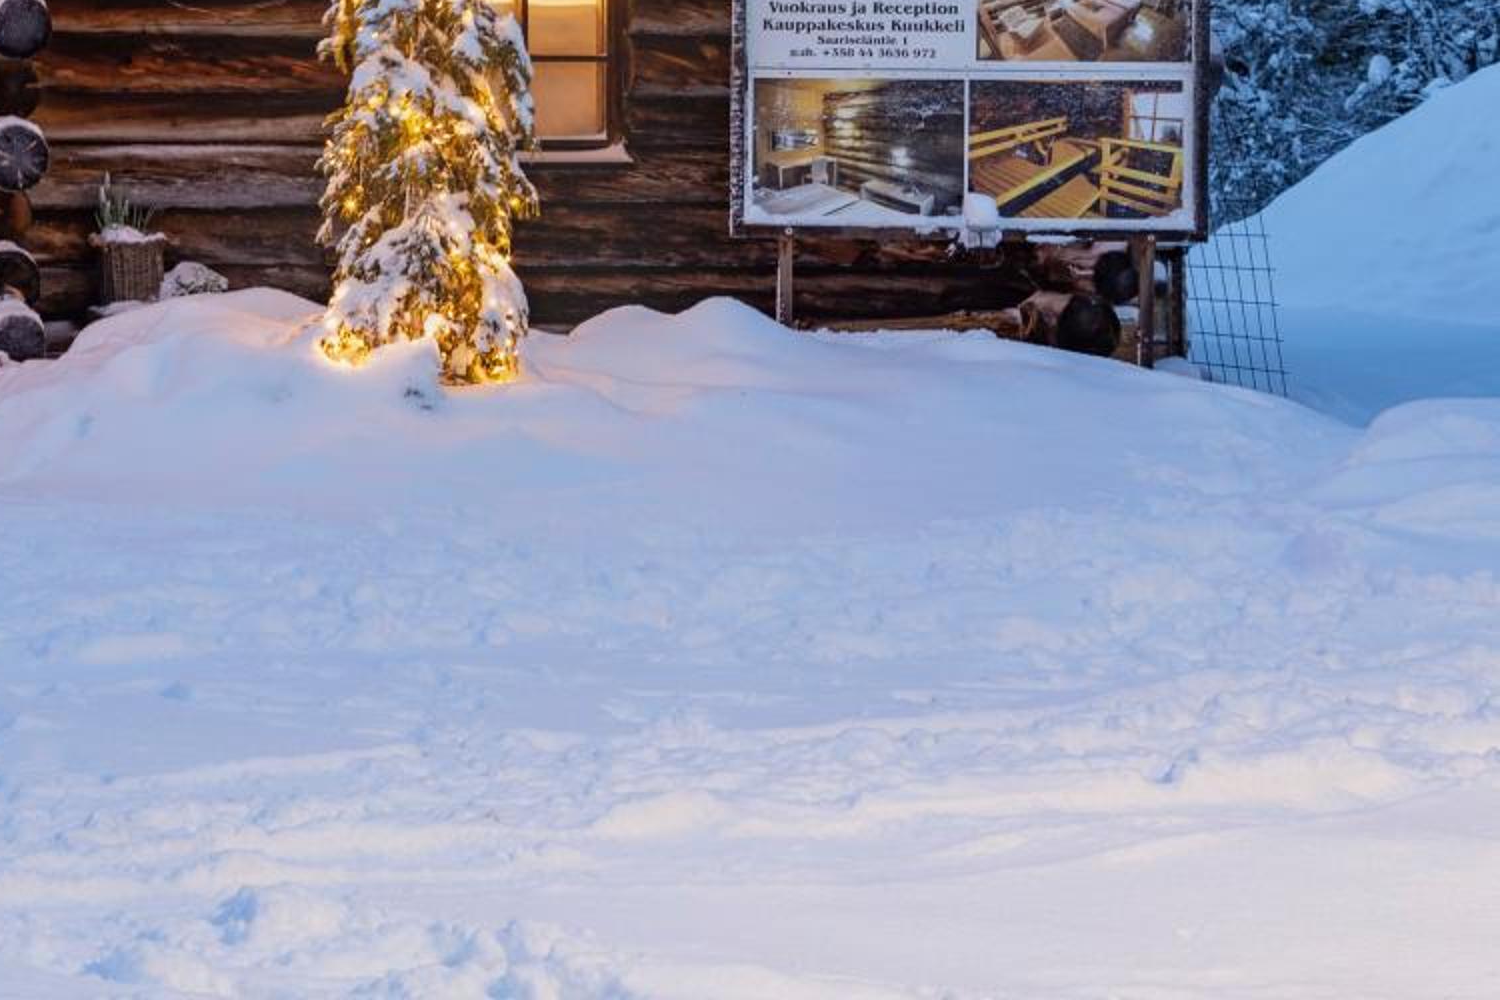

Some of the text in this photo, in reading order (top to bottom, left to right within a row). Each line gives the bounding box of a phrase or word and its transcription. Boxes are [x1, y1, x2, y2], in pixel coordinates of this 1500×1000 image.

[768, 0, 960, 17] Vuokraus ja Reception
[762, 18, 966, 33] Kauppakeskus Kuukkeli
